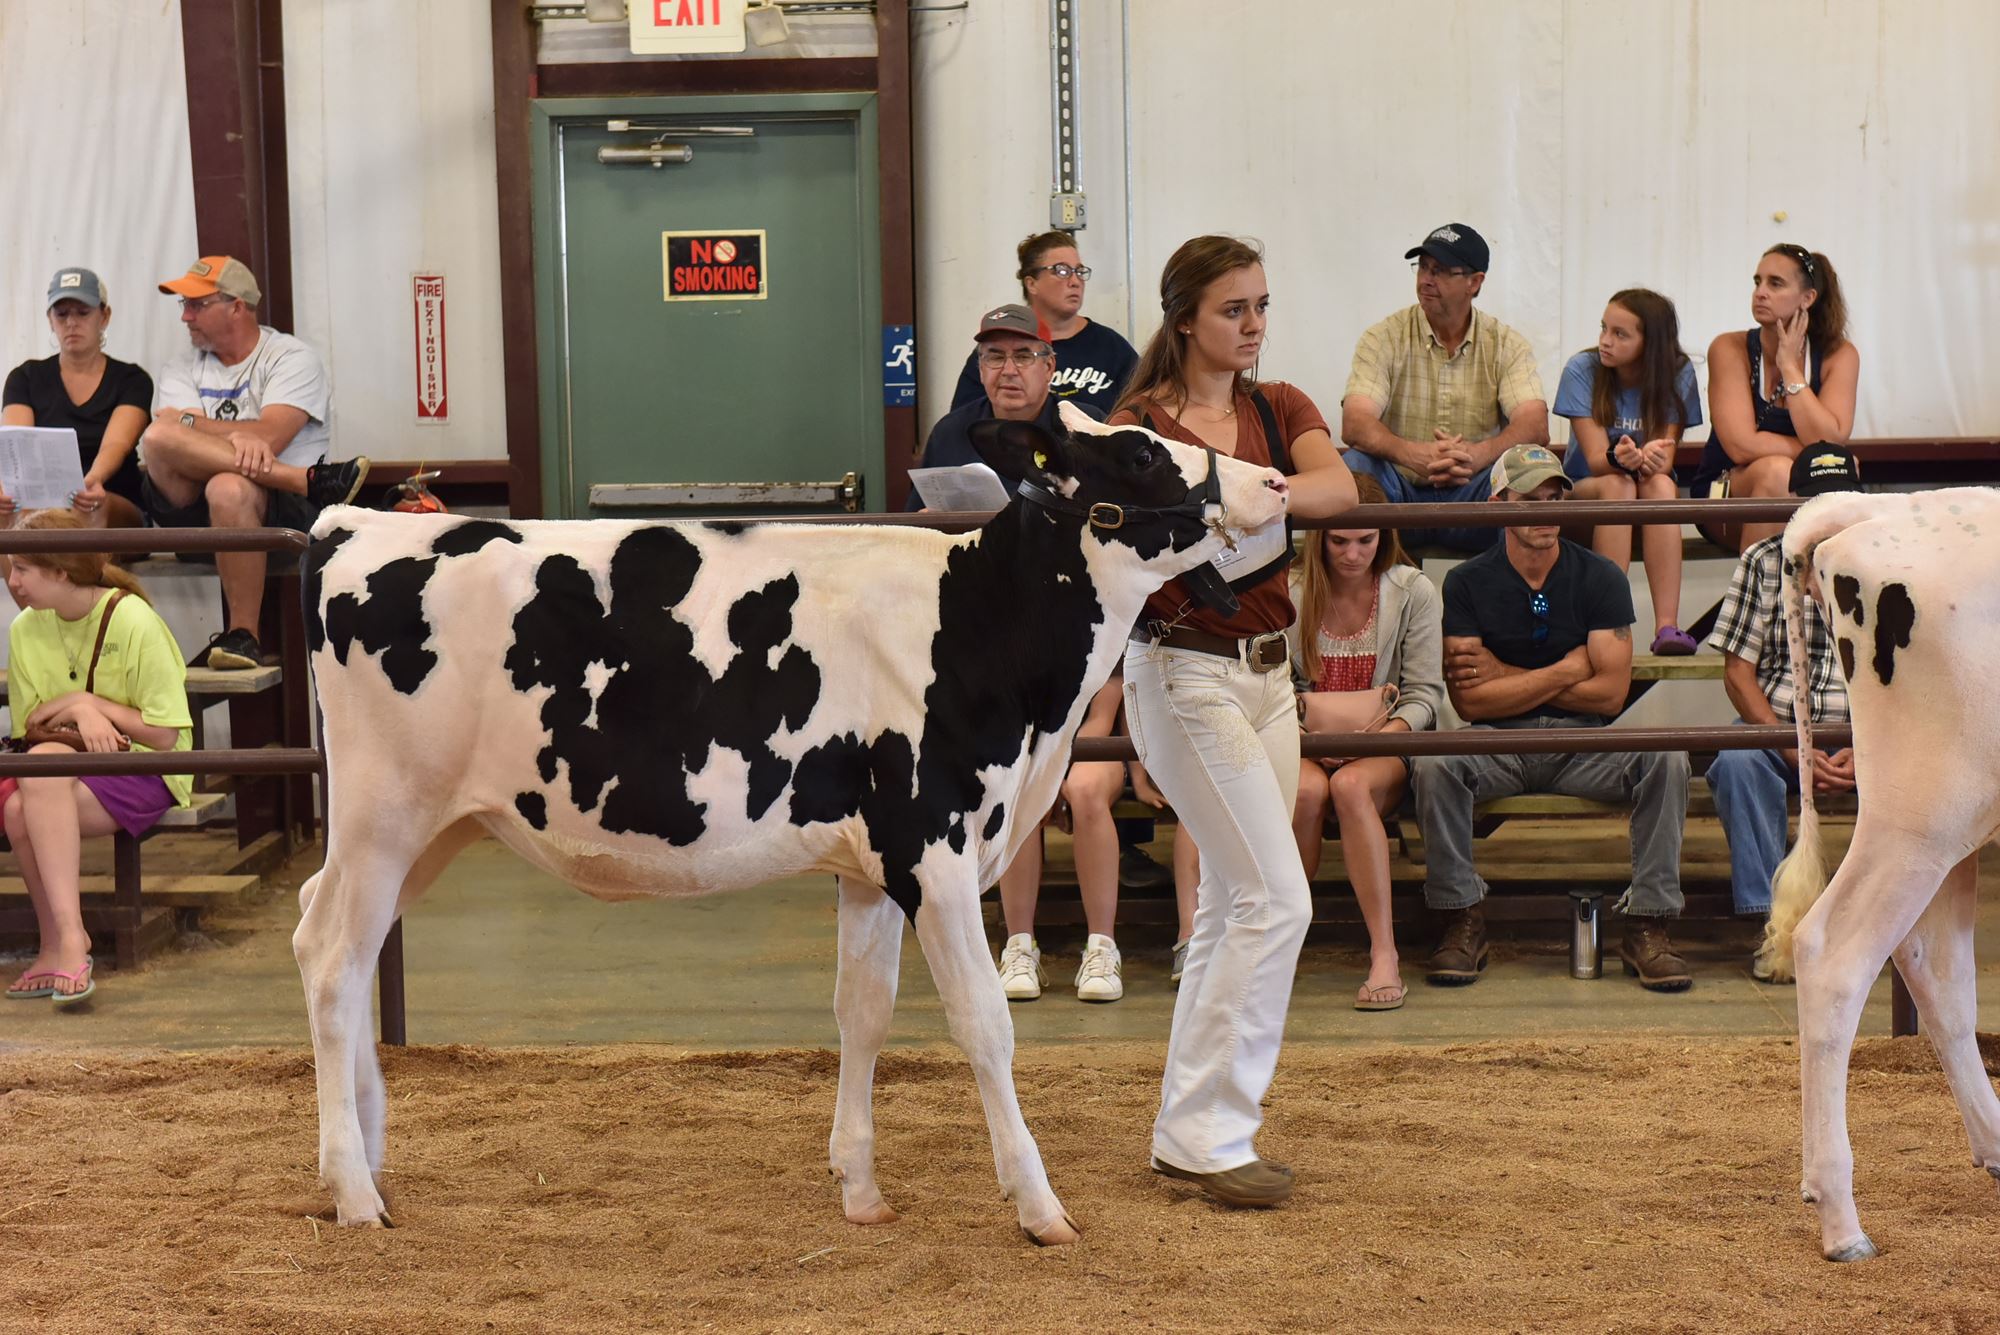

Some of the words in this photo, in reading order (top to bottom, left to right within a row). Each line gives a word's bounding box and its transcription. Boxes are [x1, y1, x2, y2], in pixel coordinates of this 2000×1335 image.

[691, 239, 737, 265] NO
[417, 284, 441, 297] FIRE
[674, 266, 757, 291] SMOKING
[425, 300, 436, 409] EXTINGUISHER
[1810, 468, 1848, 477] CHEVROLET
